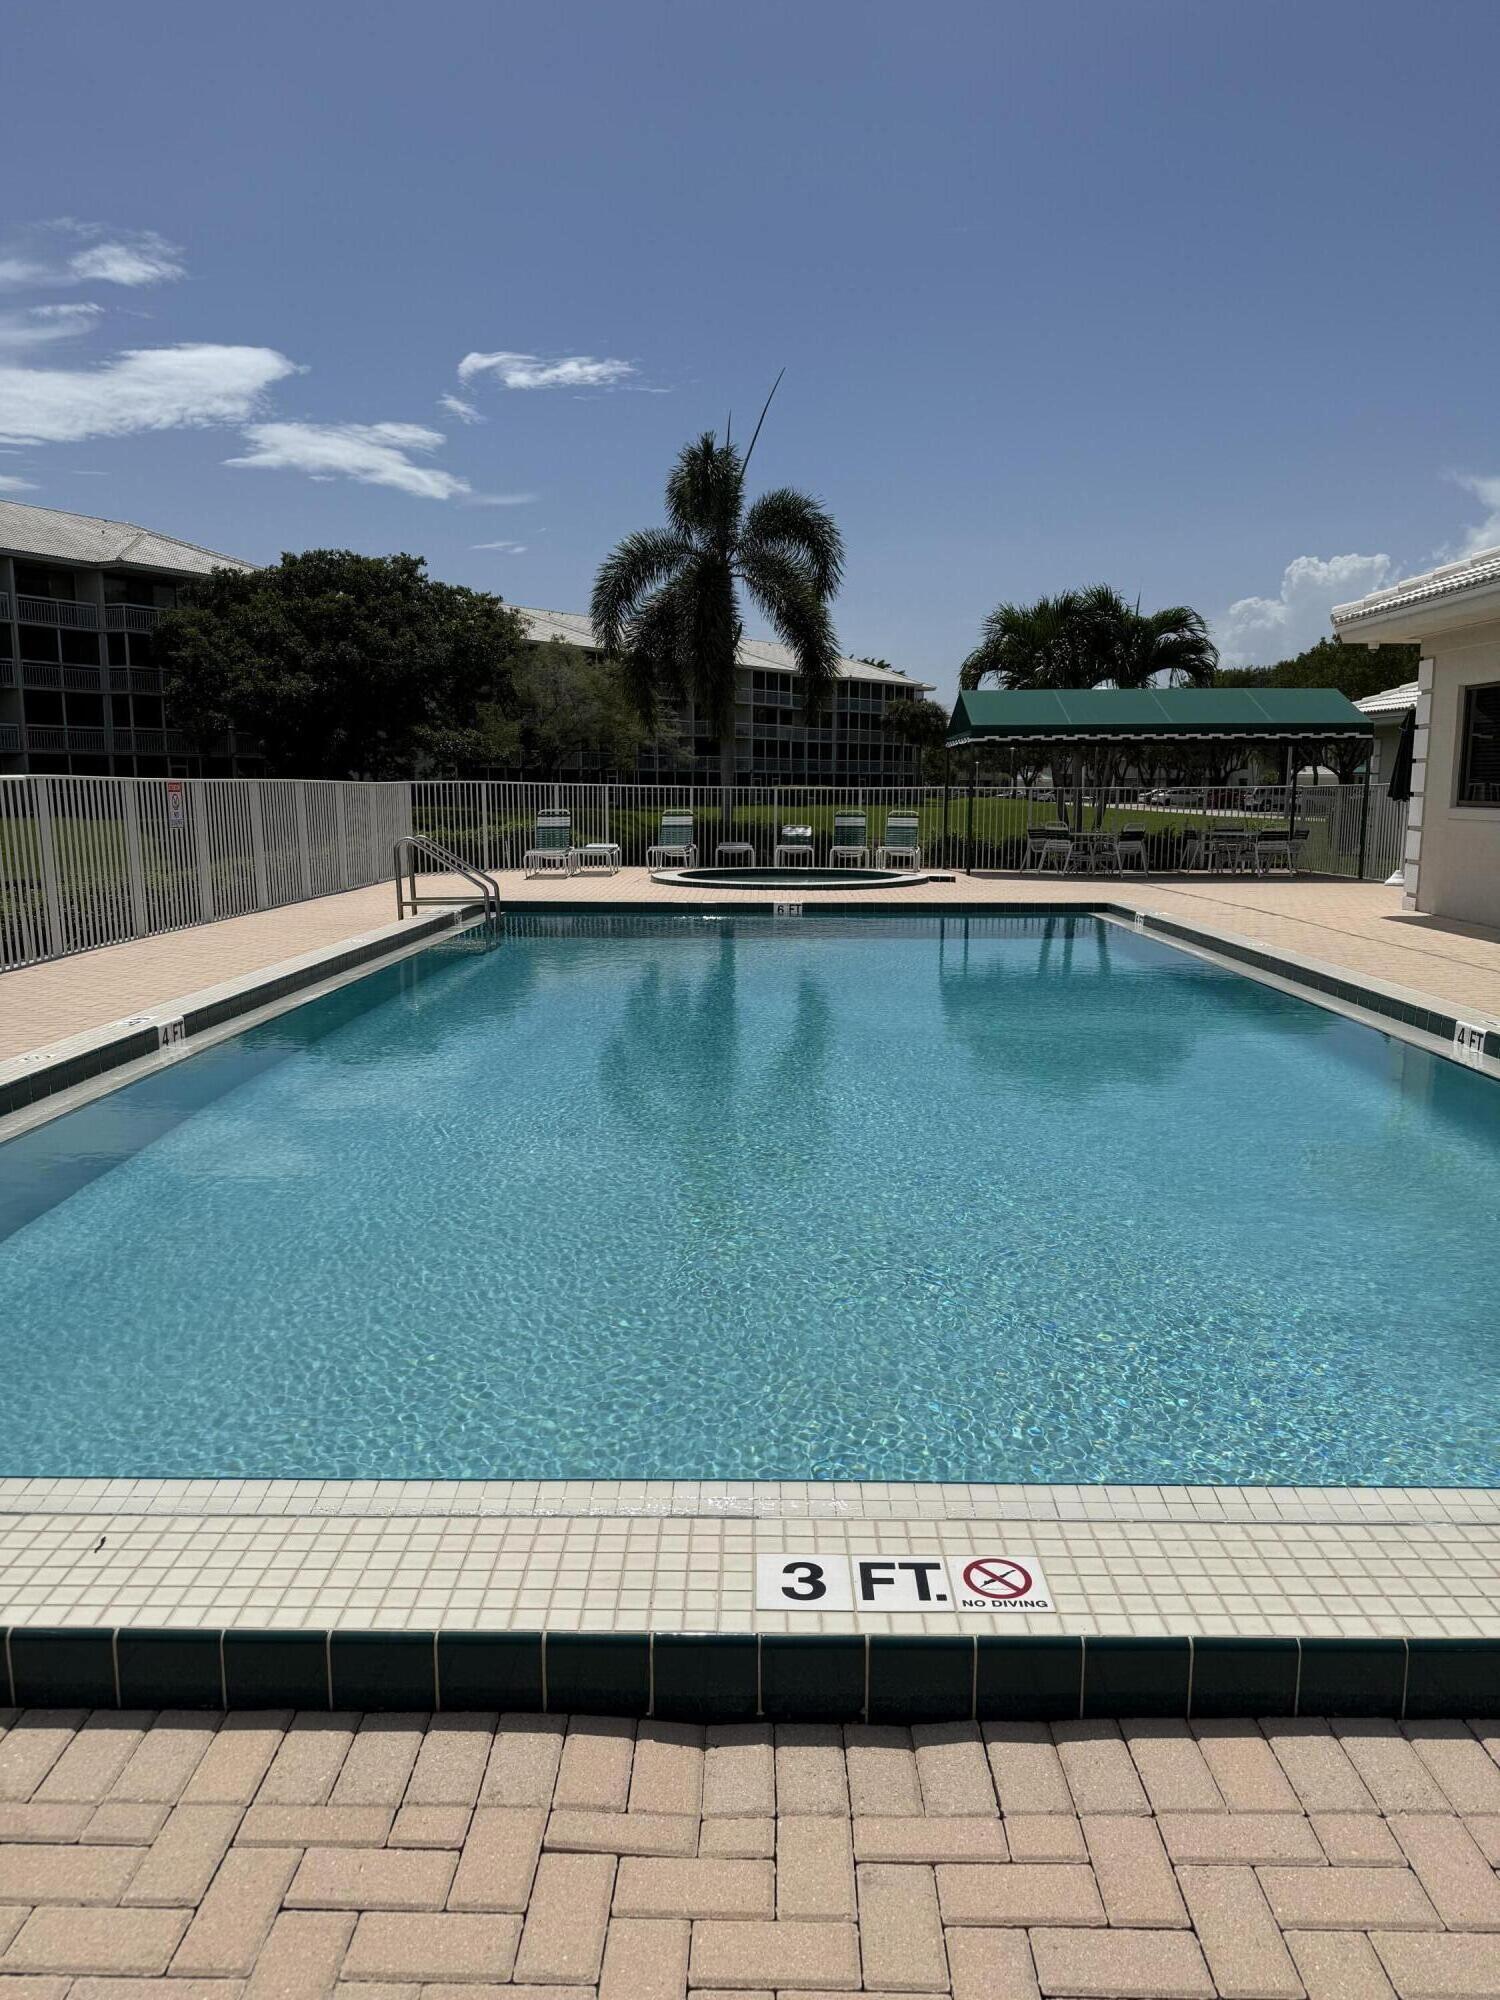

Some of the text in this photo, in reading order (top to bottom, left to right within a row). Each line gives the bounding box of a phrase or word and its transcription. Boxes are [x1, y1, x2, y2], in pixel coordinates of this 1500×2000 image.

[777, 903, 802, 917] 6 FT
[162, 1027, 170, 1046] 4
[172, 1020, 184, 1043] FT
[1457, 1027, 1484, 1051] 4 FT
[781, 1561, 948, 1602] 3 FT.
[962, 1599, 1049, 1609] NO DIVING
